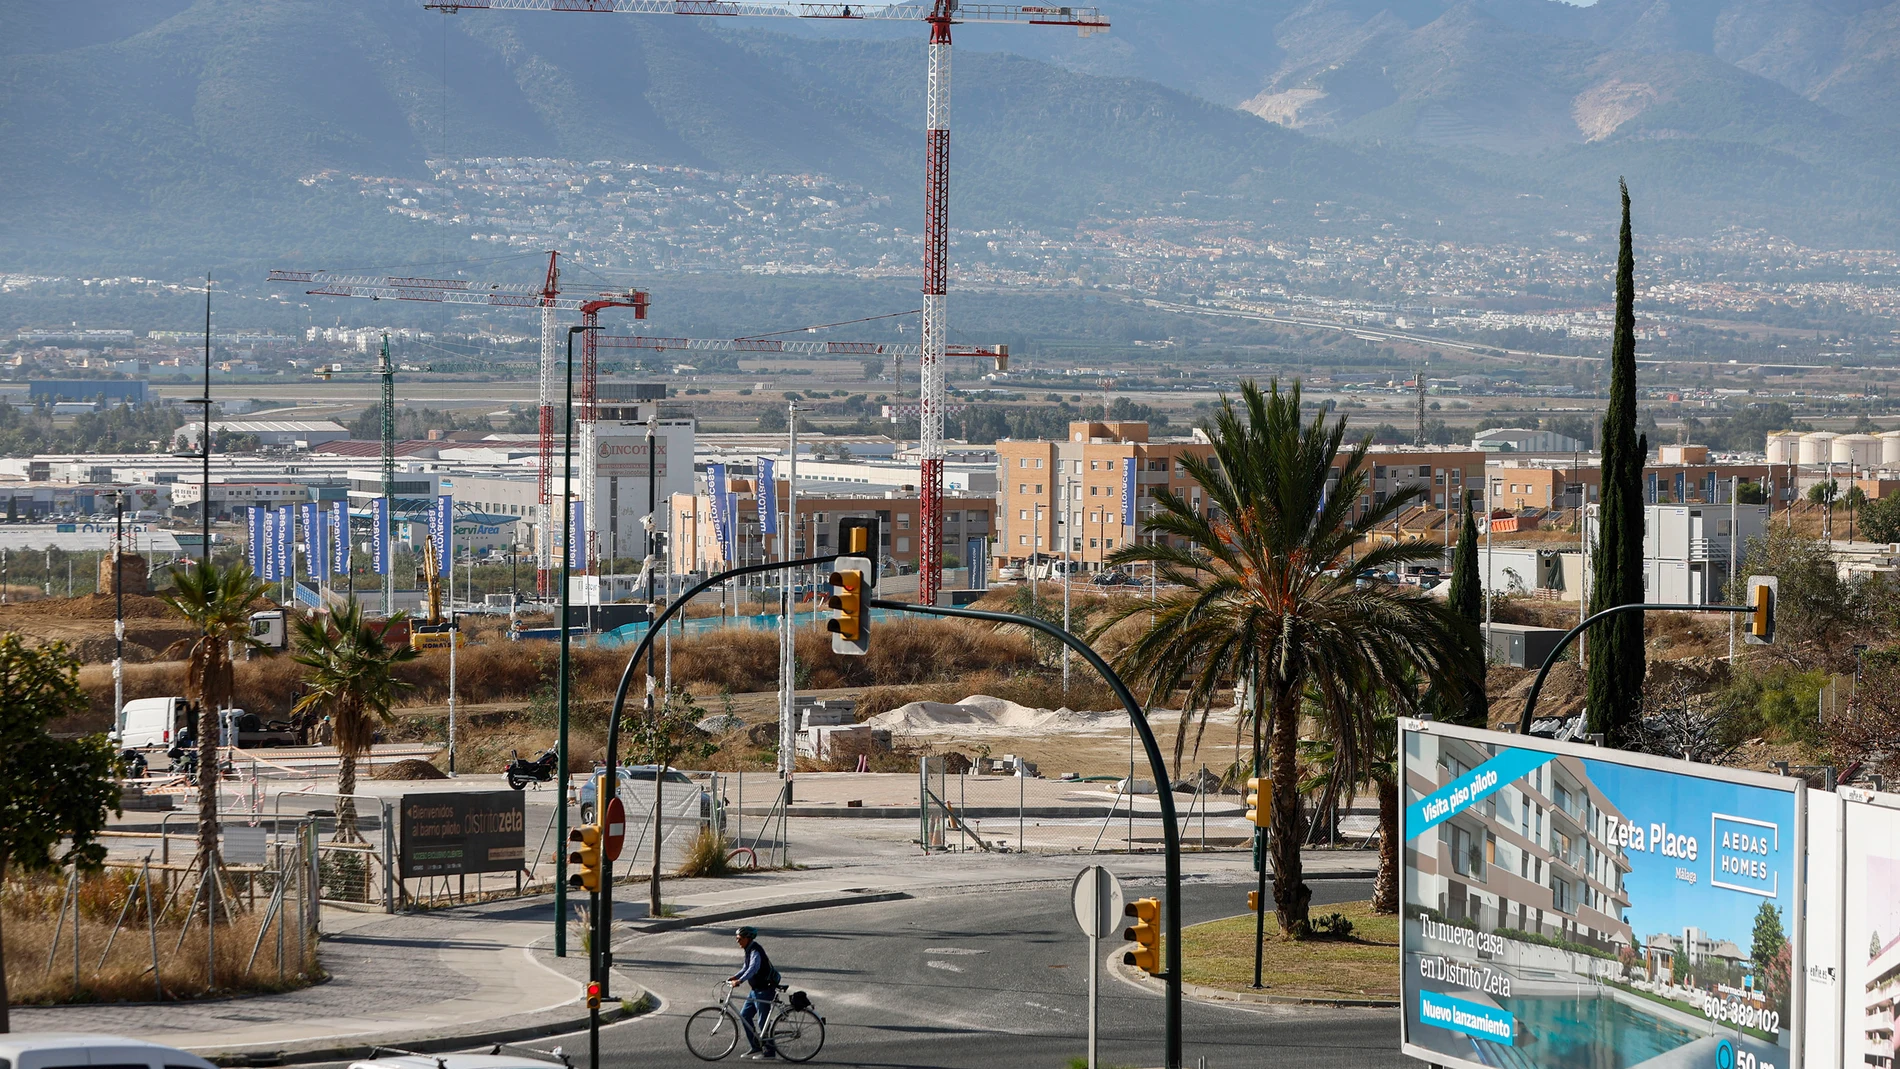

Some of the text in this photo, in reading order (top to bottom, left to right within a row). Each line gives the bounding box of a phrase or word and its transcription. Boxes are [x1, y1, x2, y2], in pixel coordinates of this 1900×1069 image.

[611, 446, 666, 455] INCOTX
[413, 804, 454, 819] Bienvenidos
[1422, 770, 1497, 823] Visita piso piloto
[1607, 815, 1698, 861] Zeta Place
[1722, 831, 1768, 855] AEDAS
[1675, 867, 1697, 885] Málaga
[1722, 855, 1767, 880] HOMES
[1420, 912, 1504, 955] Tu nueva casa
[1420, 956, 1511, 997] en Distrito Zeta
[1423, 999, 1510, 1038] Nuevo lanzamiento
[1705, 995, 1779, 1034] 605 382 102
[1737, 1050, 1756, 1069] 50
